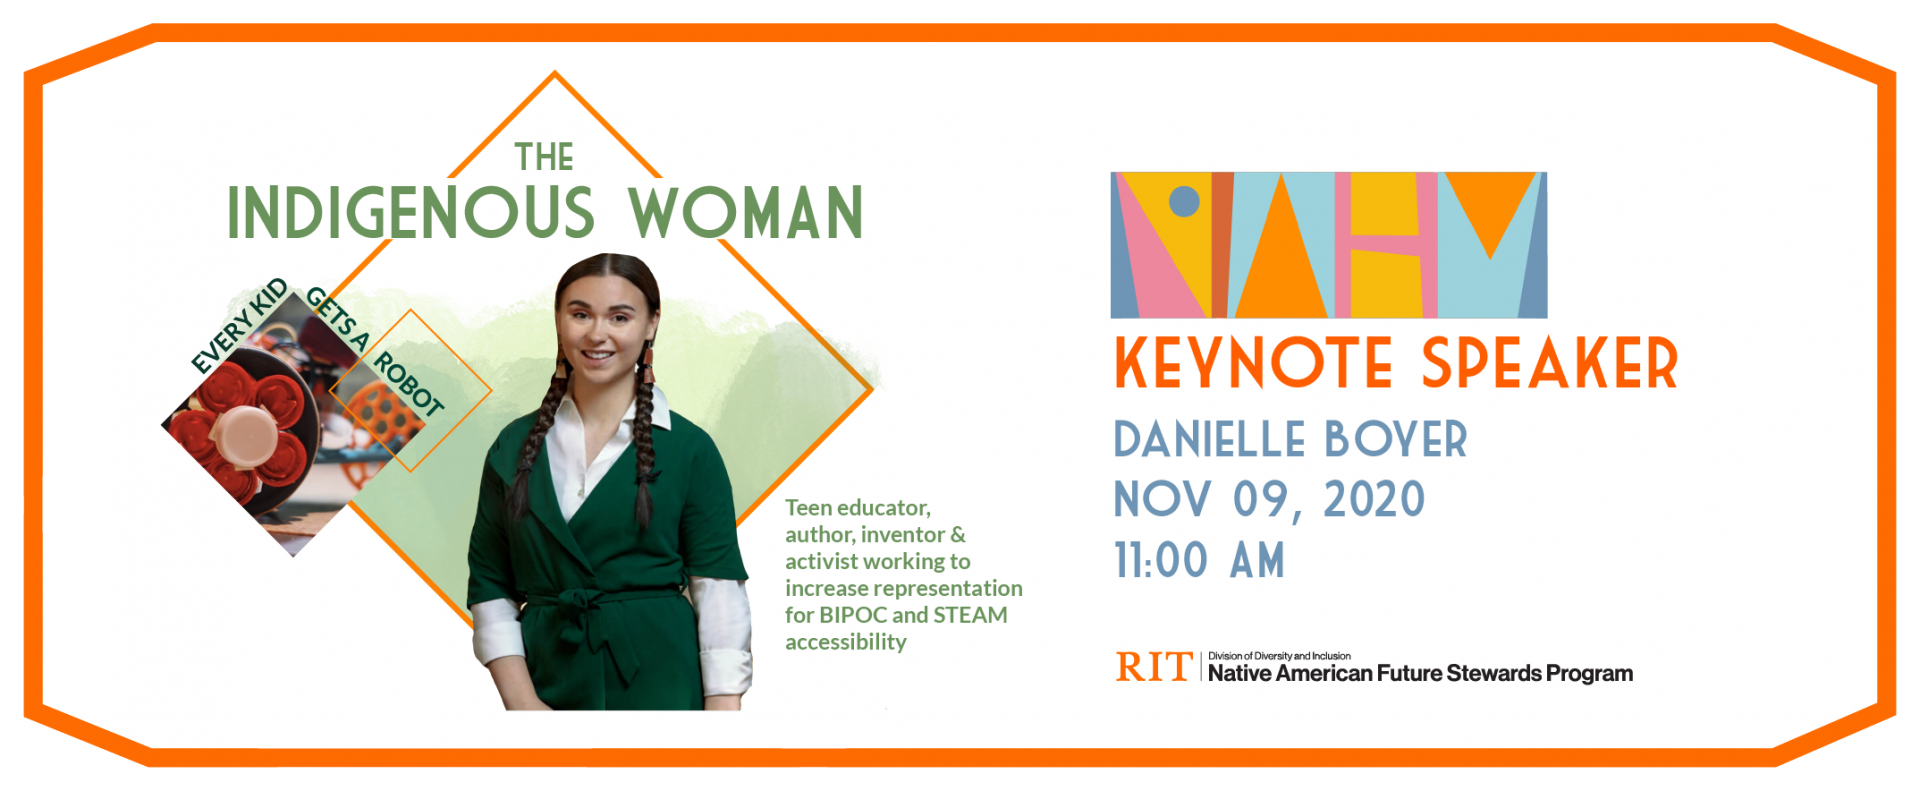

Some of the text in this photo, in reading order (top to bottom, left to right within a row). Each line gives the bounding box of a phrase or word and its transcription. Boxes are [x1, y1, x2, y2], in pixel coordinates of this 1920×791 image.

[514, 142, 572, 170] THE
[229, 185, 861, 238] INDIGENOUS WOMAN
[191, 277, 287, 374] EVERY KID
[306, 286, 445, 417] GETS A ROBOT
[1116, 334, 1678, 389] KEYNOTE SPEAKER
[1115, 419, 1467, 457] DANIELLE BOYER
[785, 498, 930, 518] Teen educator,
[1115, 479, 1424, 525] NOV 09, 2020
[786, 525, 966, 545] author, inventor &
[786, 552, 970, 573] activist working to
[1115, 540, 1283, 577] 11:00 AM
[786, 579, 1022, 600] increase representation
[785, 606, 1007, 623] for BIPOC and STEAM
[786, 632, 907, 653] accessibility
[1209, 651, 1351, 662] Division of Diversity and Inclusion
[1116, 651, 1193, 681] RIT
[1209, 664, 1633, 685] Native American Future Stewards Program
